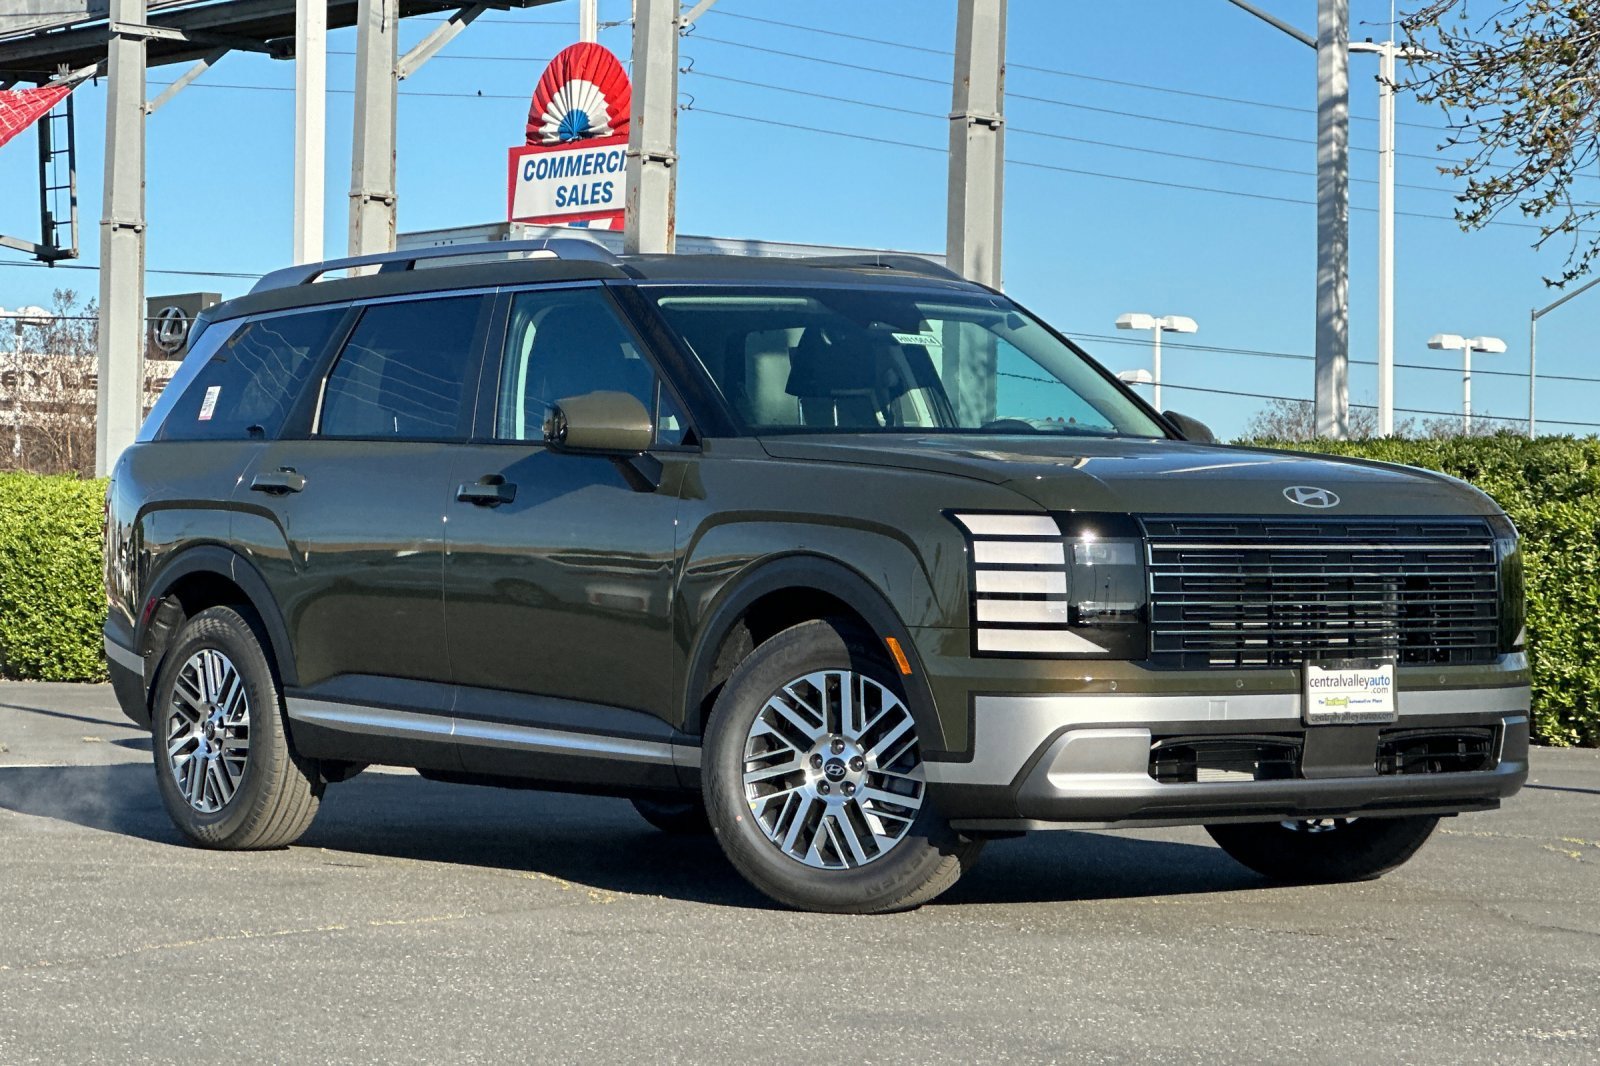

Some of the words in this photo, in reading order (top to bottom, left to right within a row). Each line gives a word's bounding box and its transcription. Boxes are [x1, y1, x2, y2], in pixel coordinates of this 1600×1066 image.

[523, 150, 628, 182] COMMERCI
[555, 181, 614, 208] SALES
[1309, 674, 1390, 690] centralvalleyauto
